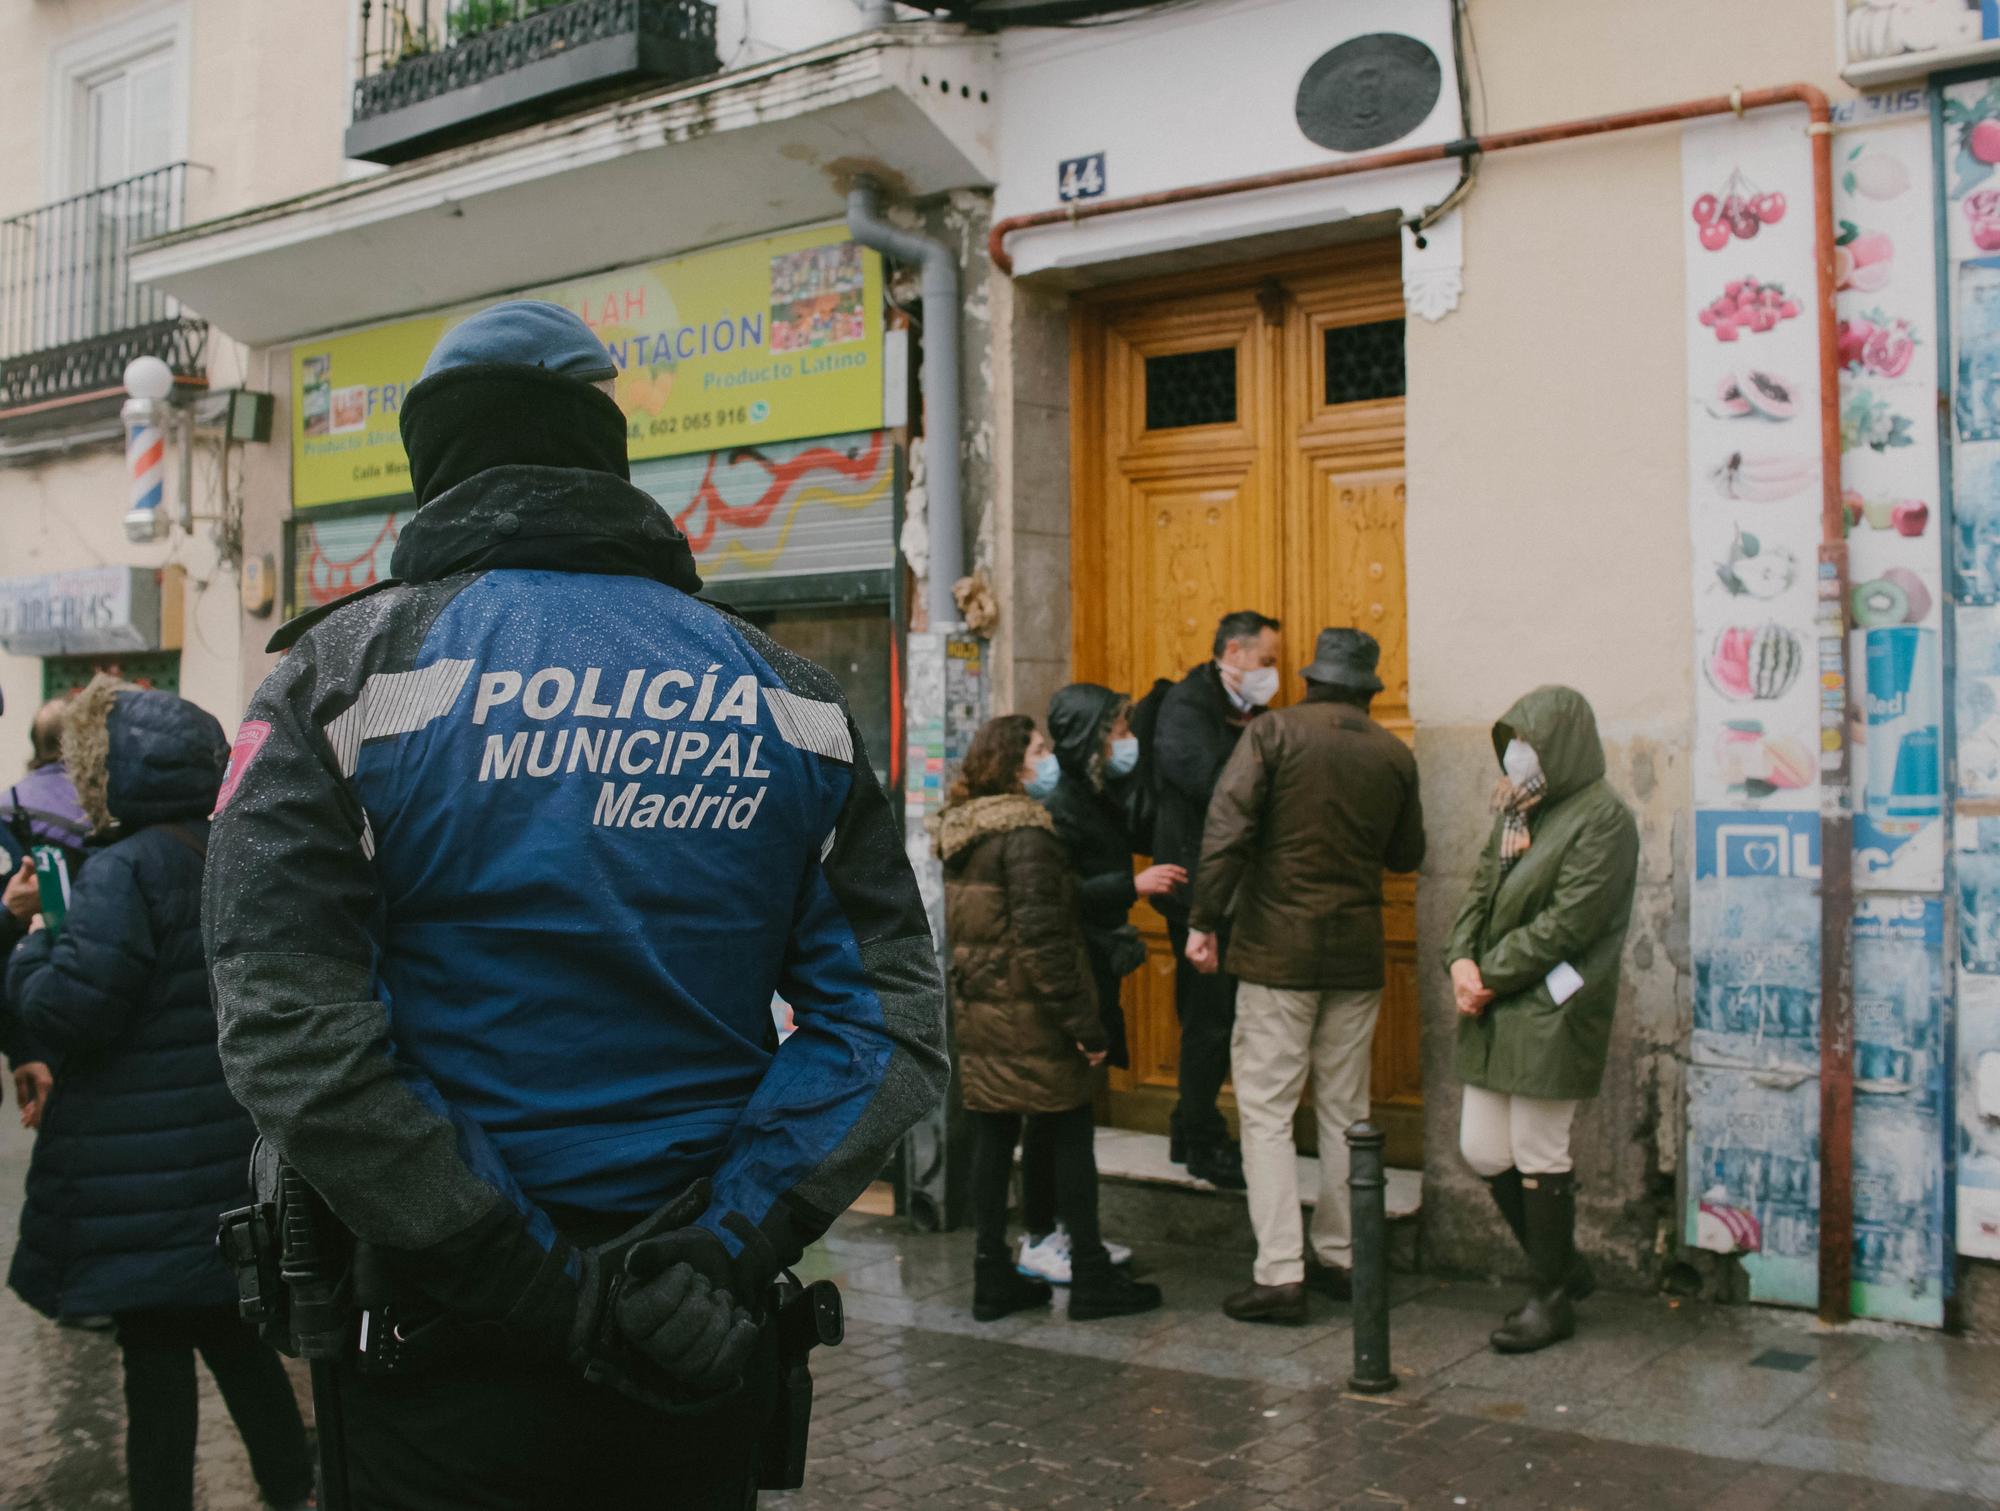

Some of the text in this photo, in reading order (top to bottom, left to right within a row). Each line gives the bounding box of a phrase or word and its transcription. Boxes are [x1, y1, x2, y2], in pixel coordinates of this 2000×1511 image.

[1061, 158, 1103, 198] 44
[703, 350, 867, 391] Producto Latino
[650, 417, 677, 436] 602
[717, 406, 747, 426] 916
[472, 664, 759, 725] POLICÍA
[478, 727, 771, 782] MUNICIPAL
[592, 782, 768, 830] Madrid
